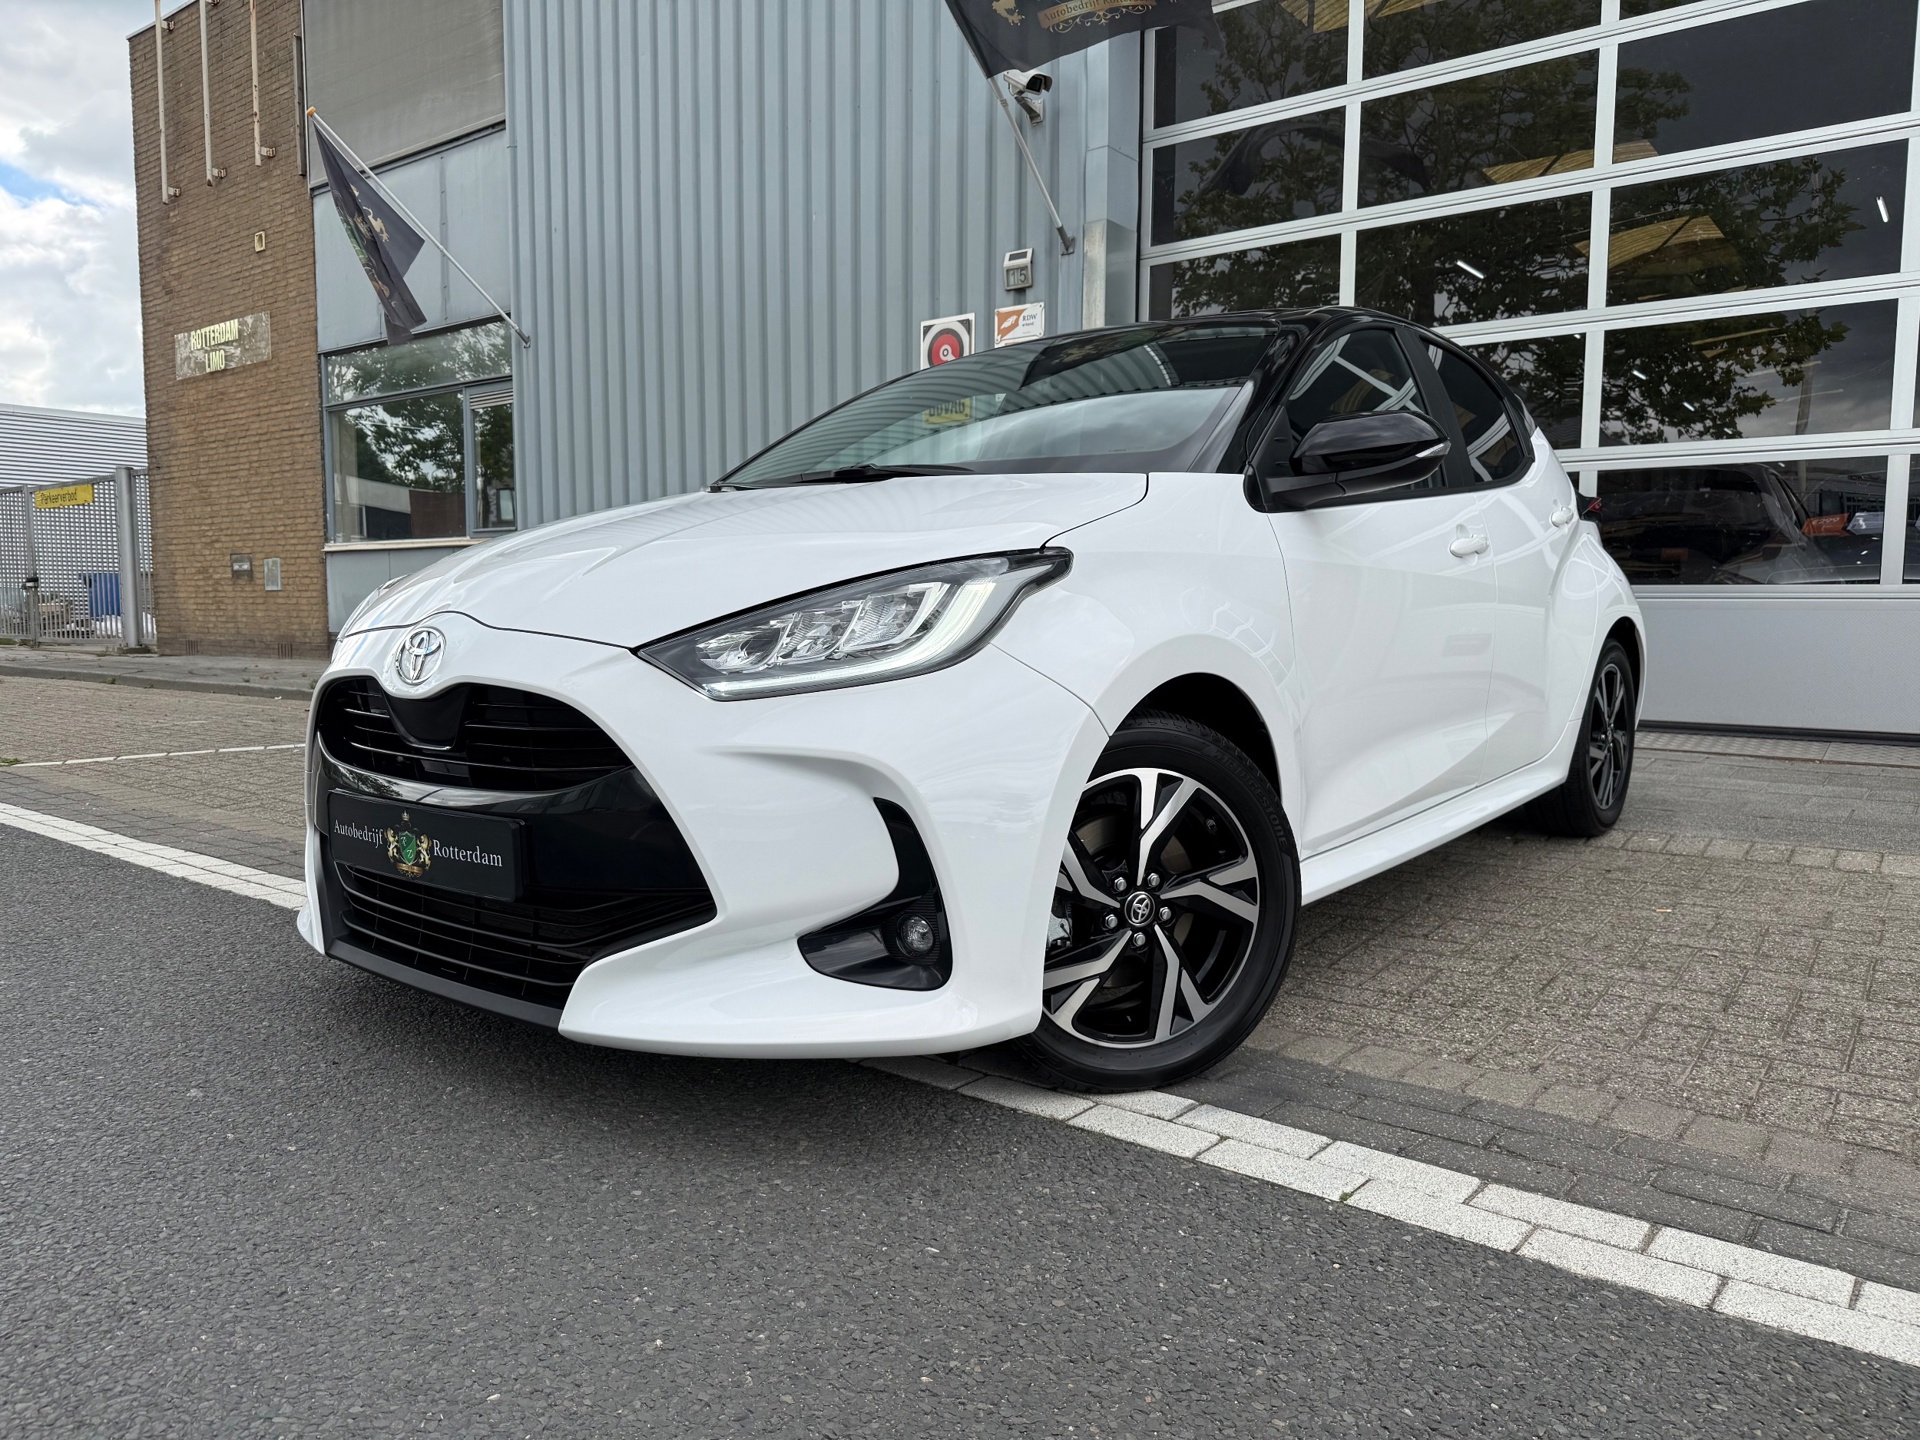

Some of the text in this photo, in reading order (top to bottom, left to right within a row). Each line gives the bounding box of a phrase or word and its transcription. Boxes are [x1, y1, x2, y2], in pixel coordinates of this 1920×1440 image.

[1011, 268, 1026, 285] 15
[1022, 313, 1037, 322] RDW
[190, 318, 239, 351] ROTTERDAM
[205, 349, 225, 373] LIMO
[40, 488, 78, 505] Parkeerverbod
[334, 819, 503, 867] Autobedrijf Rotterdam
